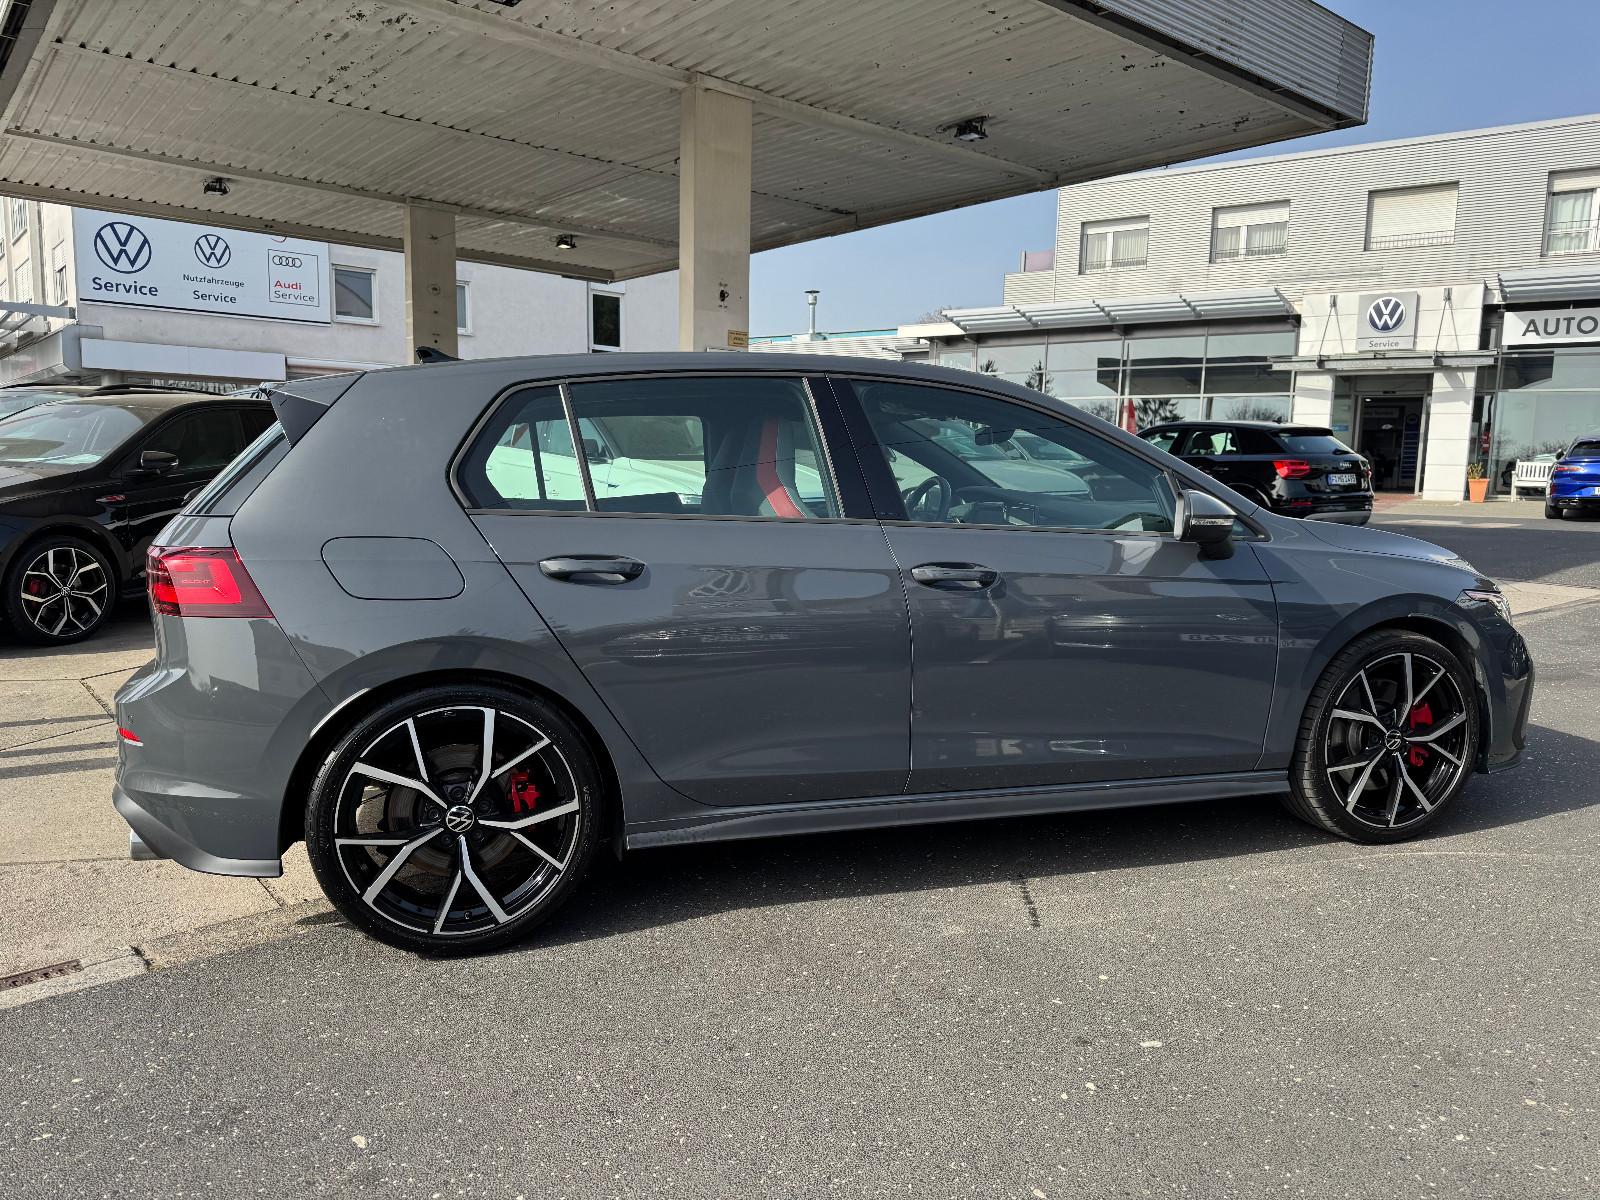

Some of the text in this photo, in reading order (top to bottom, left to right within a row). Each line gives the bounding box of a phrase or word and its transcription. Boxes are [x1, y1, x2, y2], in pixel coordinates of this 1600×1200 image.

[92, 276, 159, 296] Service
[183, 273, 245, 288] Nutzfahrzeuge
[274, 280, 302, 290] Audi
[193, 289, 237, 304] Service
[274, 290, 315, 303] Service
[1521, 315, 1599, 337] AUTO
[1369, 340, 1399, 348] Service
